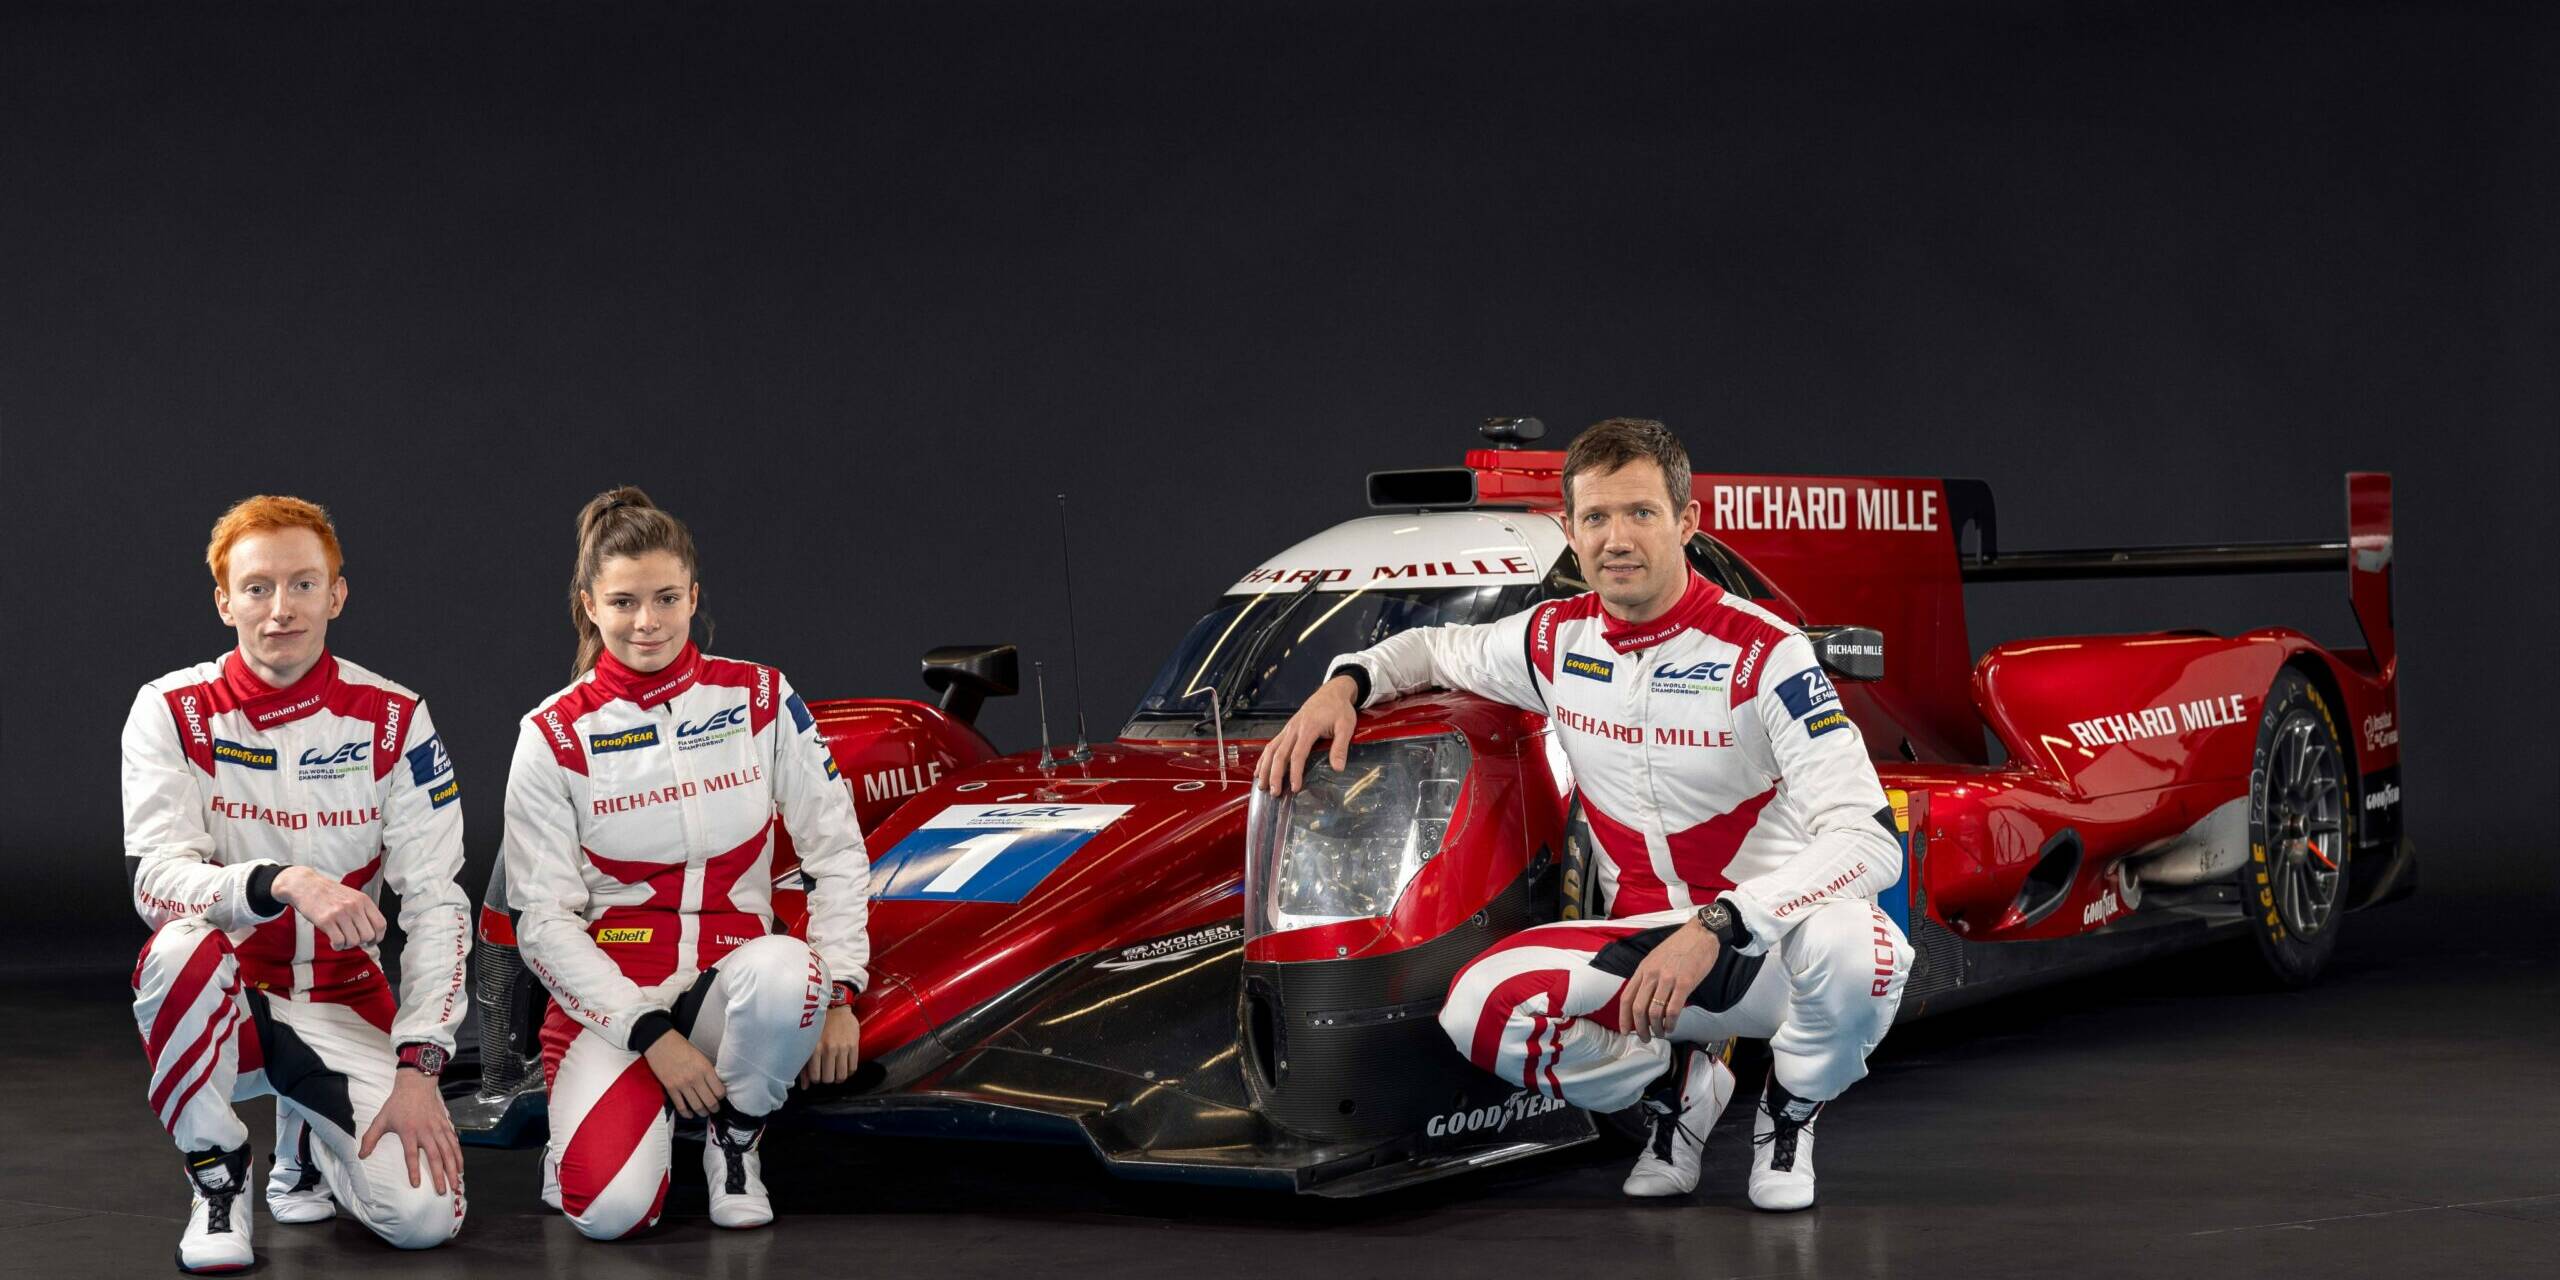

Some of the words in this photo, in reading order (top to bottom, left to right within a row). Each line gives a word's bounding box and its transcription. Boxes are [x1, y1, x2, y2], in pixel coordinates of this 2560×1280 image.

[1714, 485, 1847, 530] RICHARD
[1857, 488, 1938, 532] MILLE
[1372, 556, 1535, 580] MILLE
[1536, 606, 1557, 651] Sabelt
[1618, 635, 1655, 648] RICHARD
[1657, 623, 1682, 640] MILLE
[1736, 636, 1765, 689] Sabelt
[1827, 644, 1862, 656] RICHARD
[1863, 645, 1883, 656] MILLE
[643, 680, 677, 701] RICHARD
[677, 668, 695, 686] MILLE
[1653, 661, 1732, 682] WEC
[755, 667, 769, 709] Sabelt
[1810, 695, 1823, 706] LE
[181, 695, 208, 745] Sabelt
[258, 704, 296, 723] RICHARD
[297, 694, 321, 711] MILLE
[677, 704, 747, 738] WEC
[2068, 706, 2177, 749] RICHARD
[2179, 694, 2248, 732] MILLE
[381, 699, 401, 752] Sabelt
[543, 710, 575, 751] Sabelt
[593, 731, 654, 749] GOODYEAR
[688, 736, 710, 744] WORLD
[1556, 705, 1644, 744] RICHARD
[1655, 726, 1734, 749] MILLE
[215, 745, 273, 765] GOODYEAR
[299, 740, 372, 766] WEC
[678, 739, 724, 751] CHAMPIONSHIP
[298, 773, 345, 781] CHAMPIONSHIP
[593, 779, 697, 816] RICHARD
[703, 765, 761, 793] MILLE
[211, 795, 307, 831] RICHARD
[317, 806, 382, 828] MILLE
[922, 834, 1023, 893] 1
[1826, 862, 1867, 894] MILLE
[601, 928, 647, 943] Sabelt
[1151, 924, 1232, 949] WOMEN
[1126, 953, 1139, 961] IN
[1426, 1089, 1567, 1137] GOODYEAR
